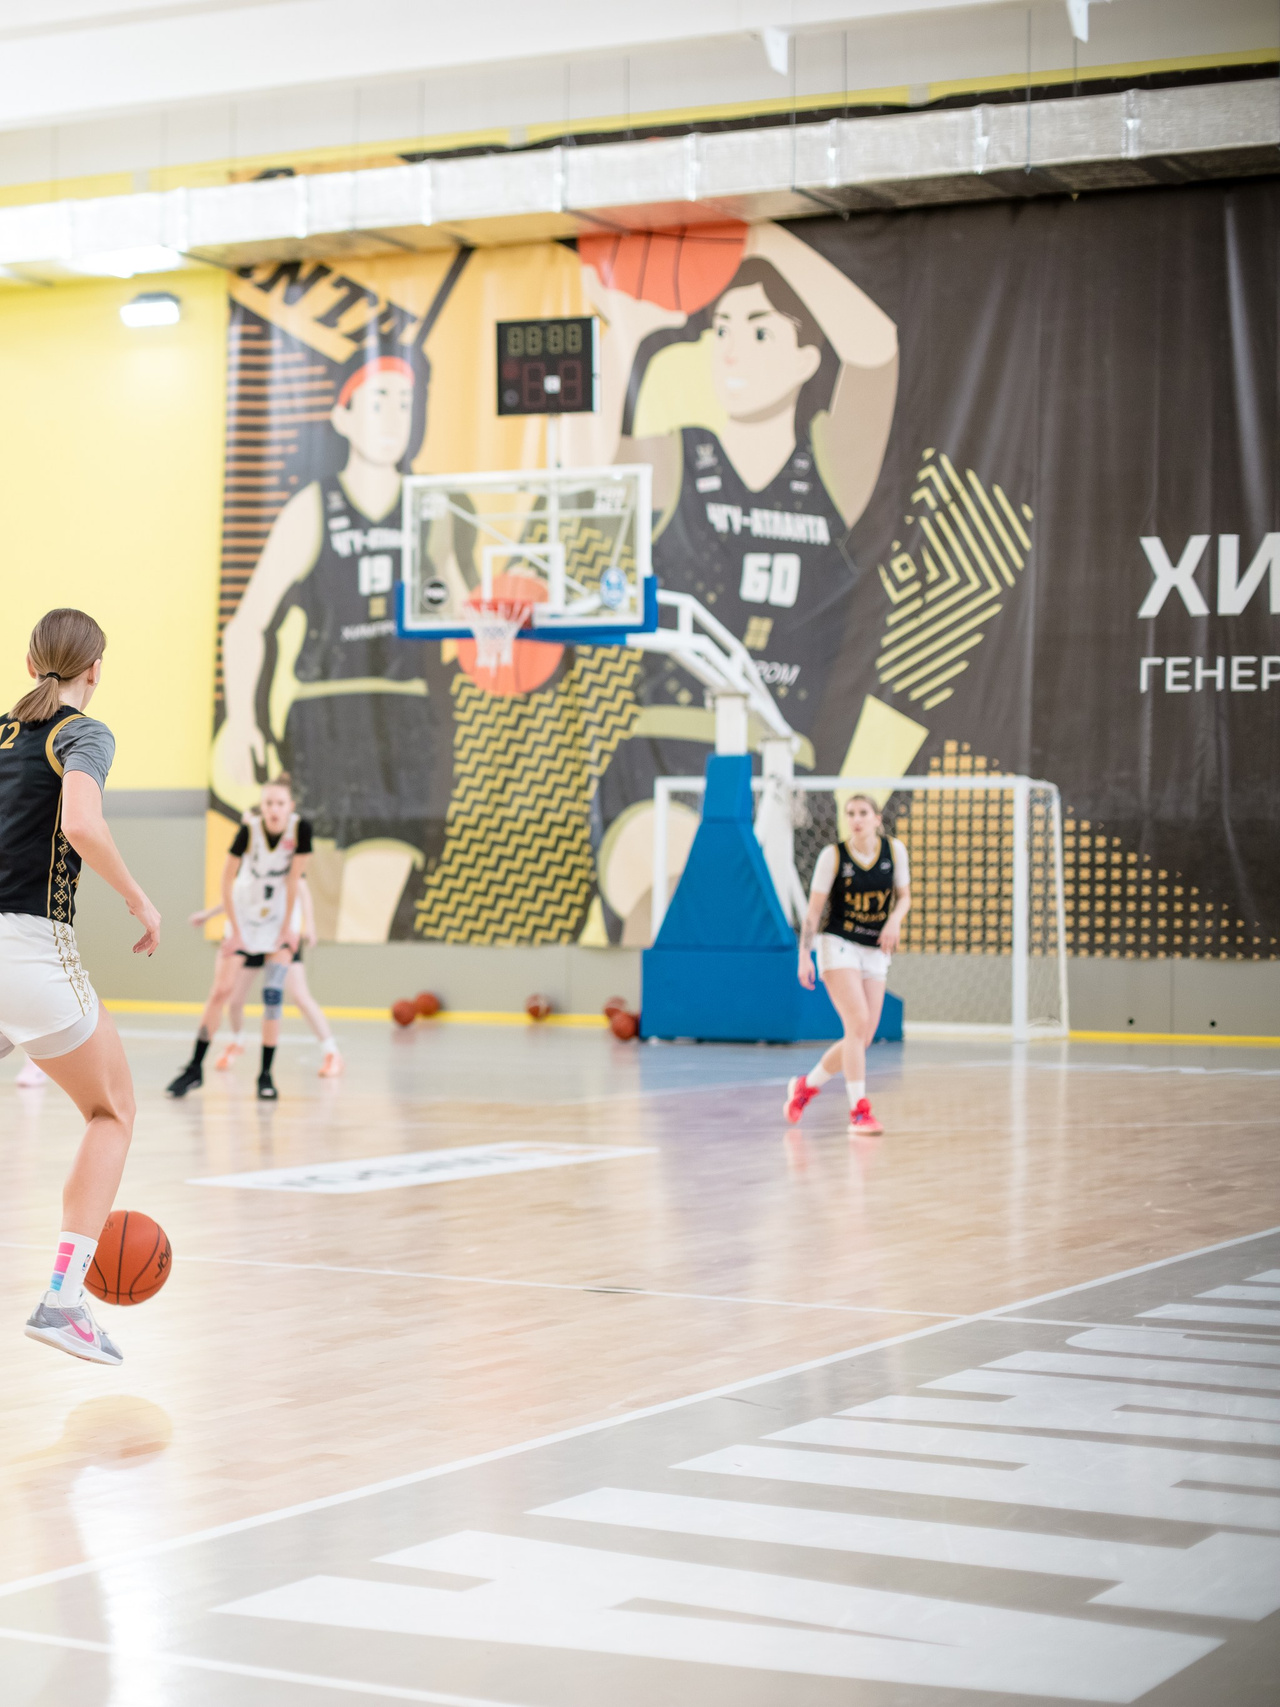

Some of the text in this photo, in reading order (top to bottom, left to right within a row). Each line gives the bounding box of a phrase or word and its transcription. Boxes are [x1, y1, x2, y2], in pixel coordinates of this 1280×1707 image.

[358, 554, 393, 596] 19
[739, 552, 801, 608] 60
[1138, 532, 1280, 619] ХИ
